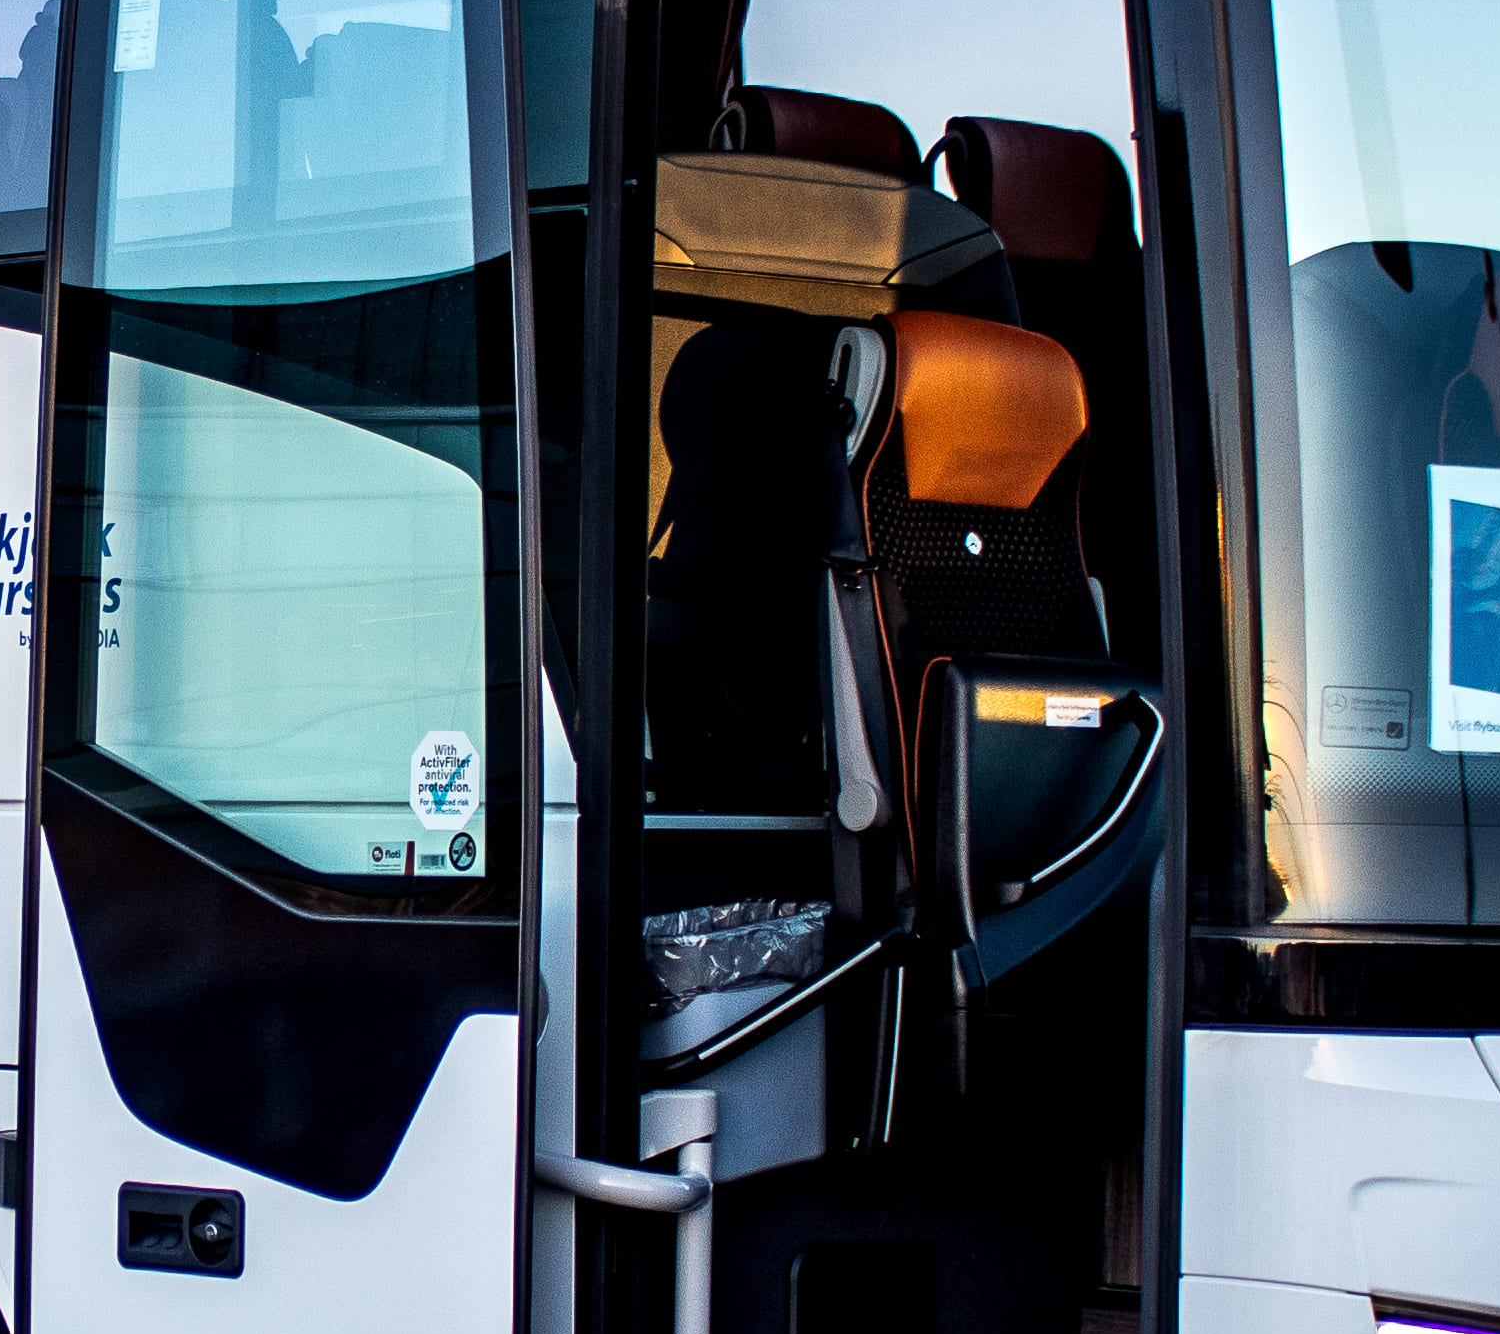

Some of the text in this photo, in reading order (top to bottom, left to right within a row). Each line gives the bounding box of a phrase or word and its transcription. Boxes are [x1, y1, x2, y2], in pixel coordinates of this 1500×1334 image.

[434, 744, 457, 756] With
[420, 756, 471, 768] ActivFilter
[425, 769, 466, 780] antiviral
[418, 781, 472, 795] protection.
